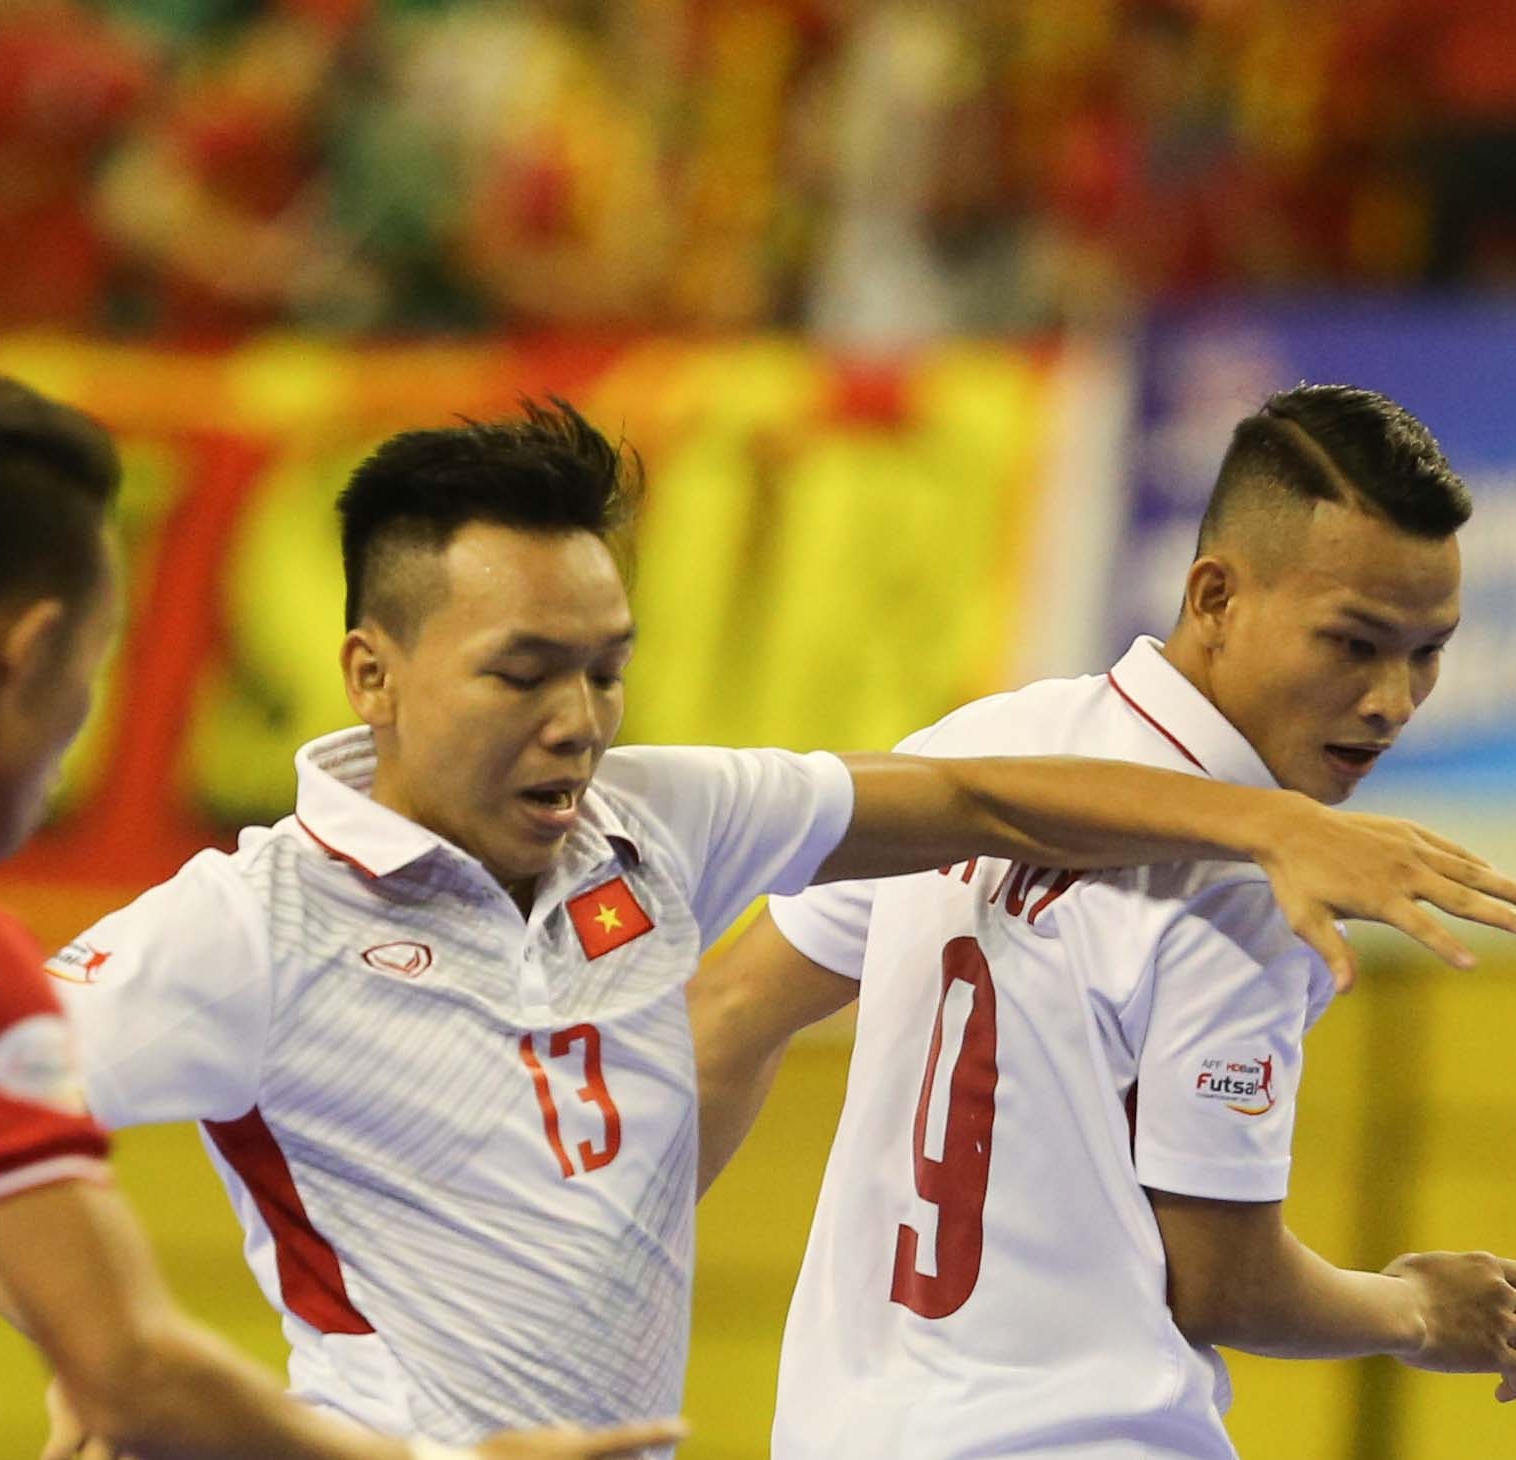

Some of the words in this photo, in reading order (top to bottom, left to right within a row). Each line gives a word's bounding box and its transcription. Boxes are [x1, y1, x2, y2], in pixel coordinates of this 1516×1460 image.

[518, 1022, 622, 1179] 13
[889, 935, 998, 1321] 9
[1196, 1071, 1260, 1096] Futsal
